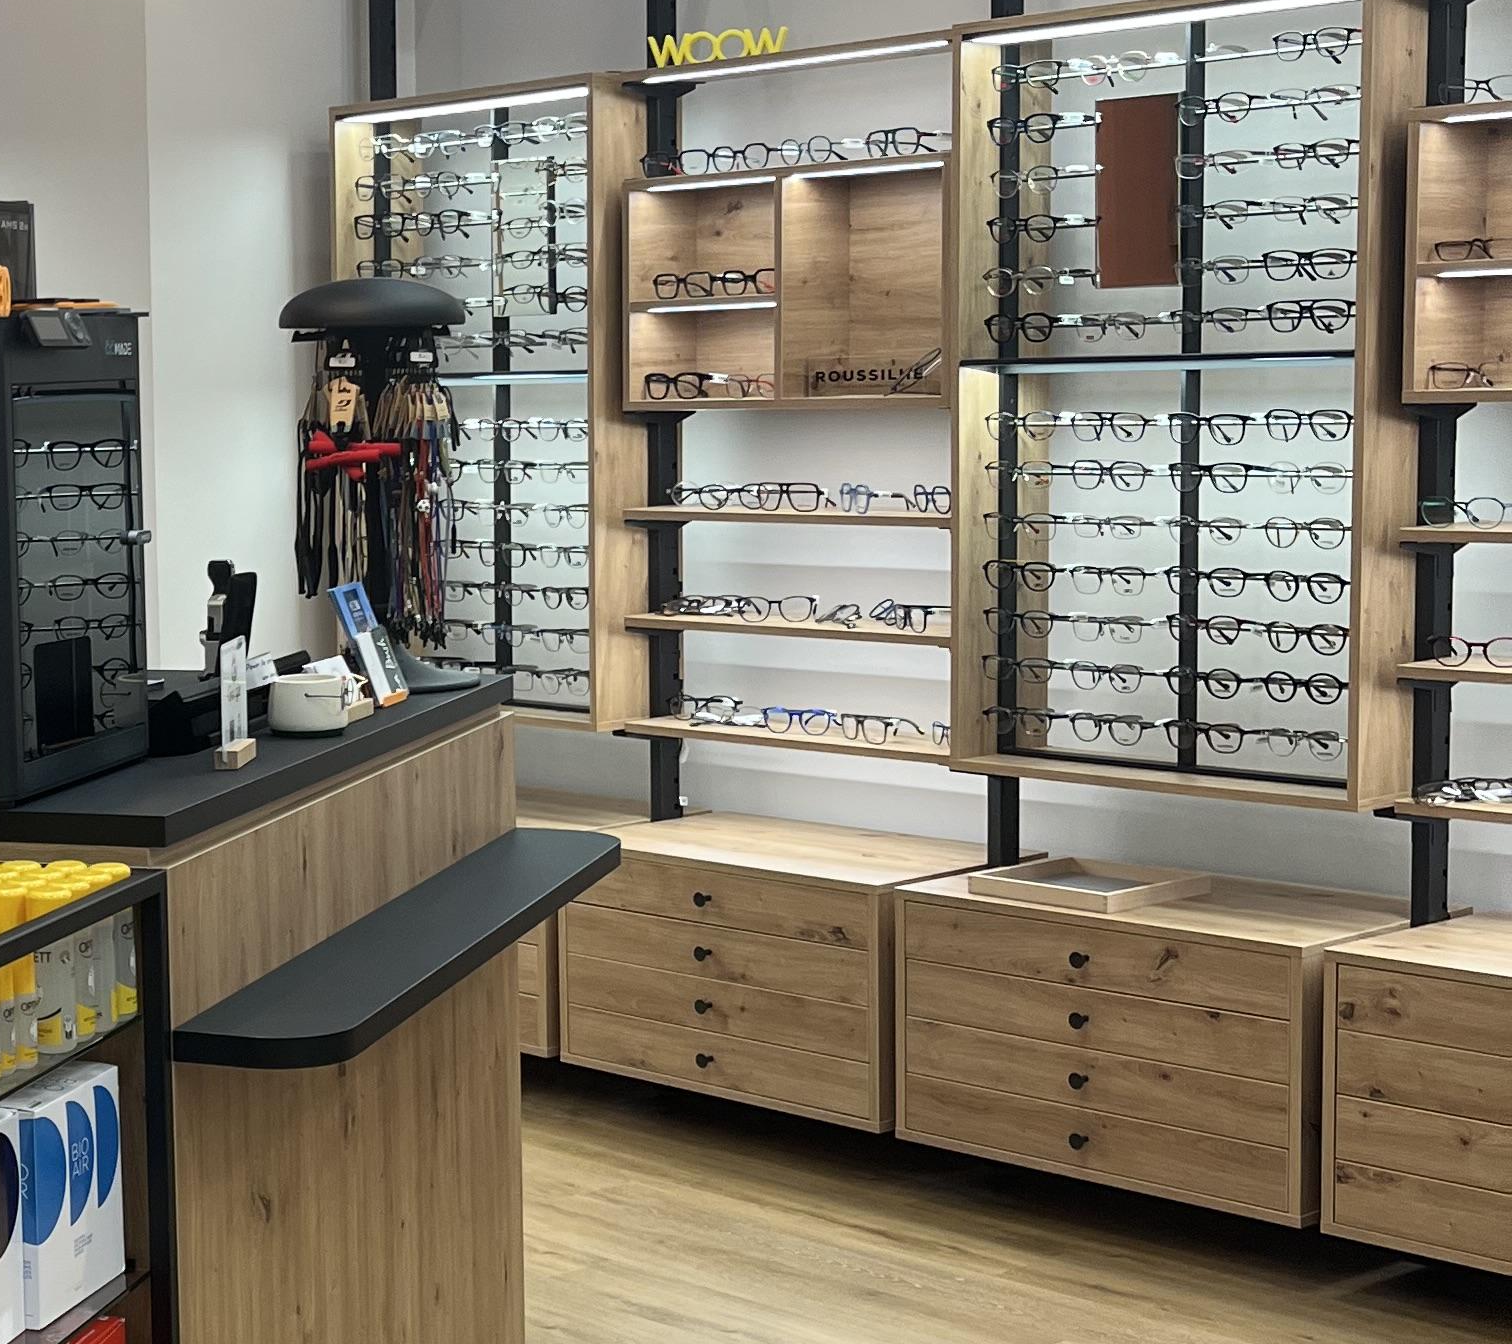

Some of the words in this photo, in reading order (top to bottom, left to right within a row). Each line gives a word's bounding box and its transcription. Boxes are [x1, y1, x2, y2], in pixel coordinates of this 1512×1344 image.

[648, 26, 787, 69] WOOW
[72, 1137, 90, 1162] BIO
[72, 1157, 90, 1180] AIR
